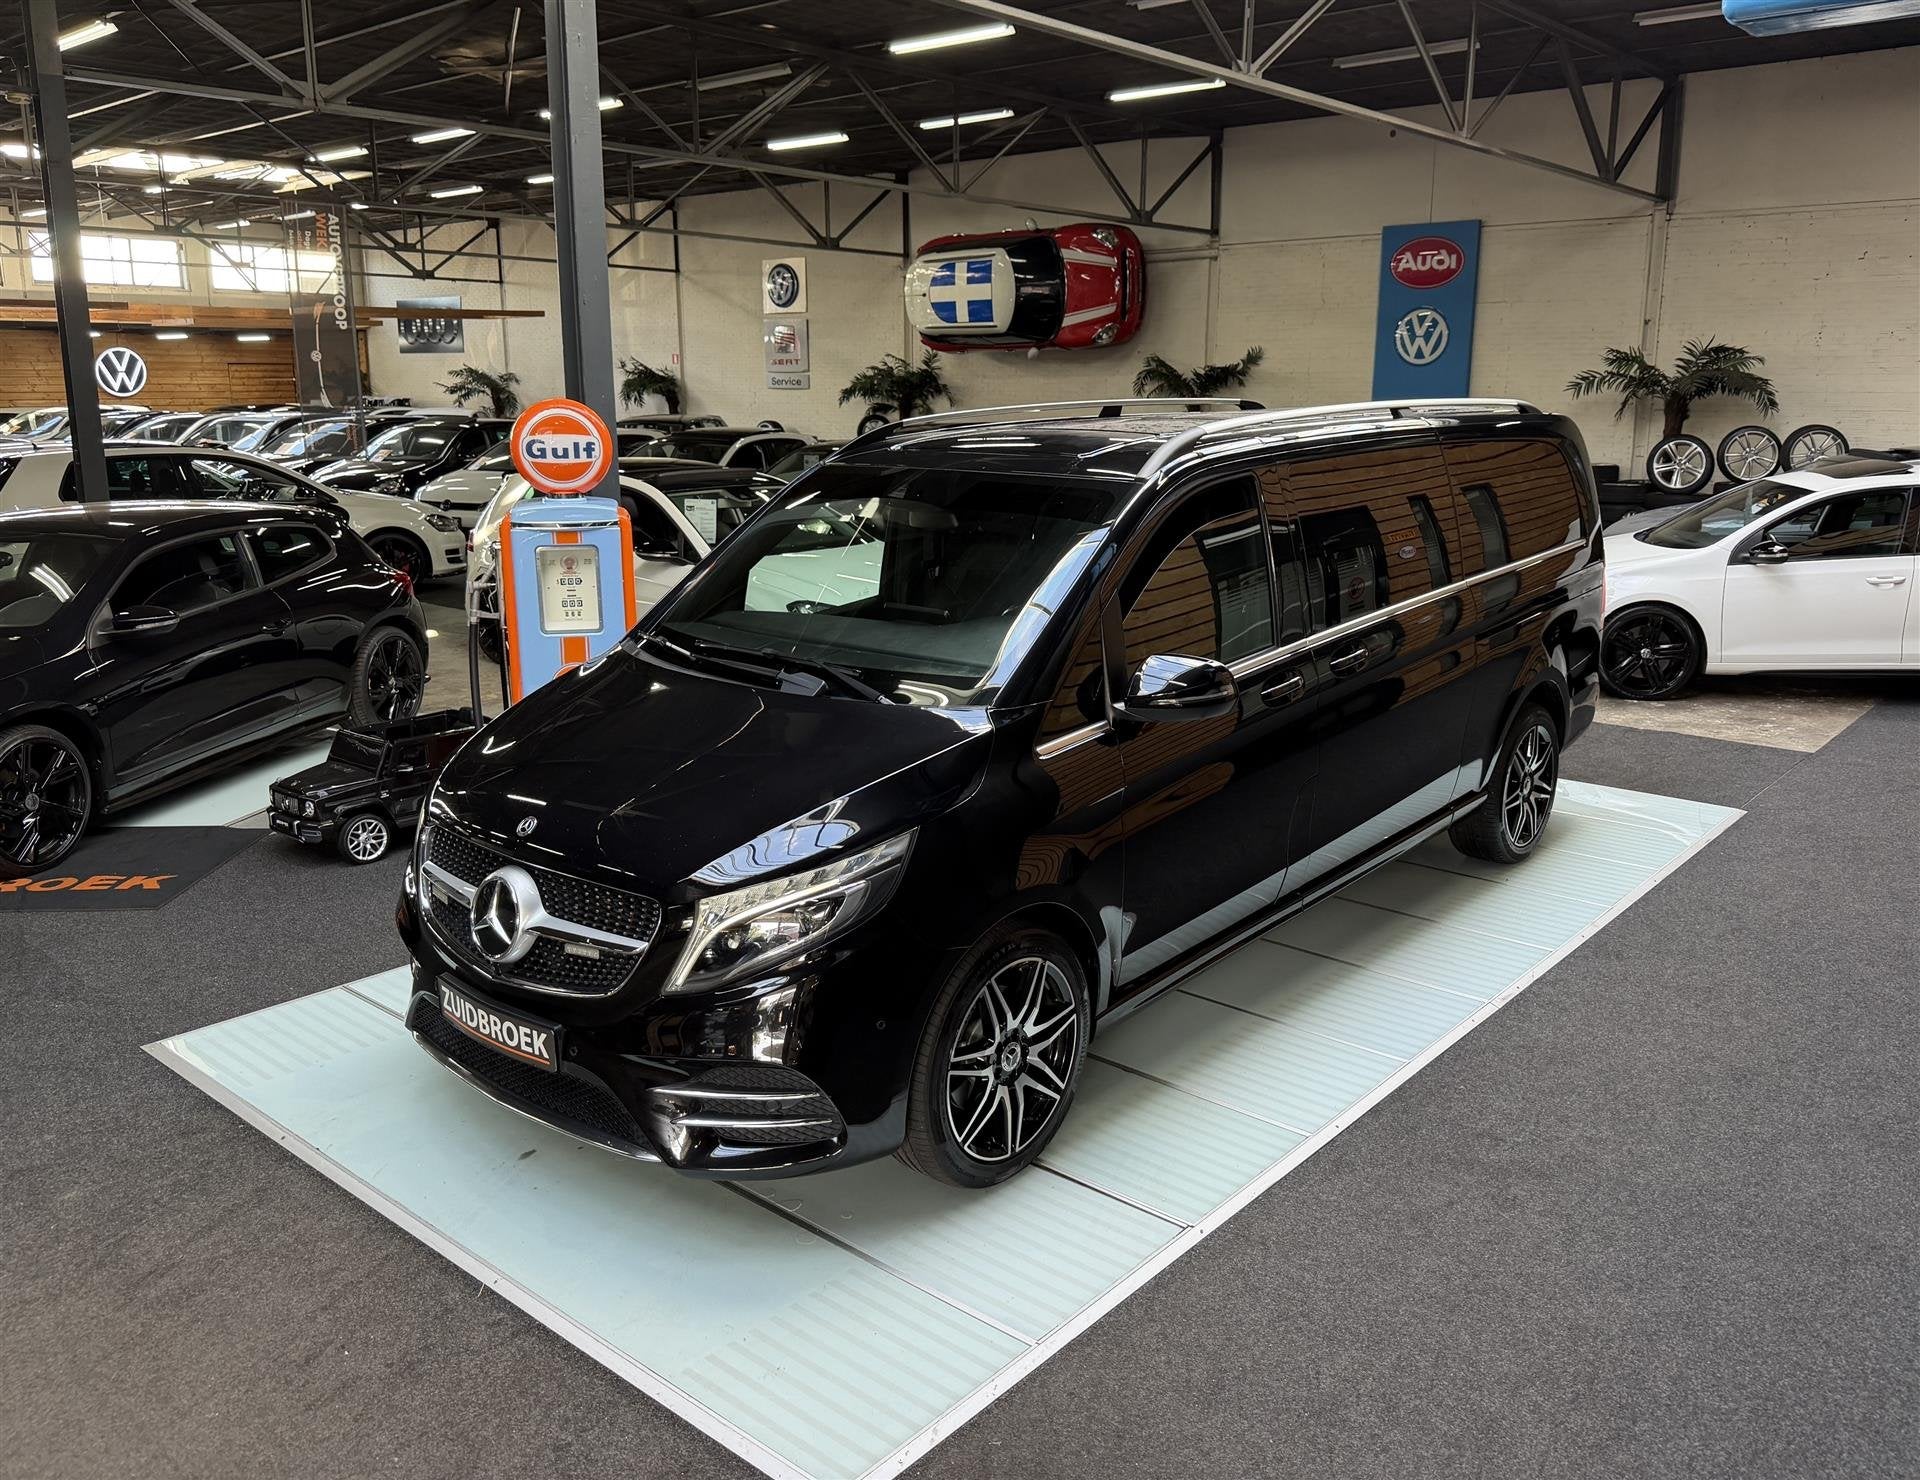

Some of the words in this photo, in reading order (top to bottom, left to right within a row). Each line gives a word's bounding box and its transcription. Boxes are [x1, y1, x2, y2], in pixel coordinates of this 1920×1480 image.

[771, 376, 802, 387] Service
[525, 438, 596, 459] Gulf
[441, 985, 550, 1059] ZUIDBROEK
